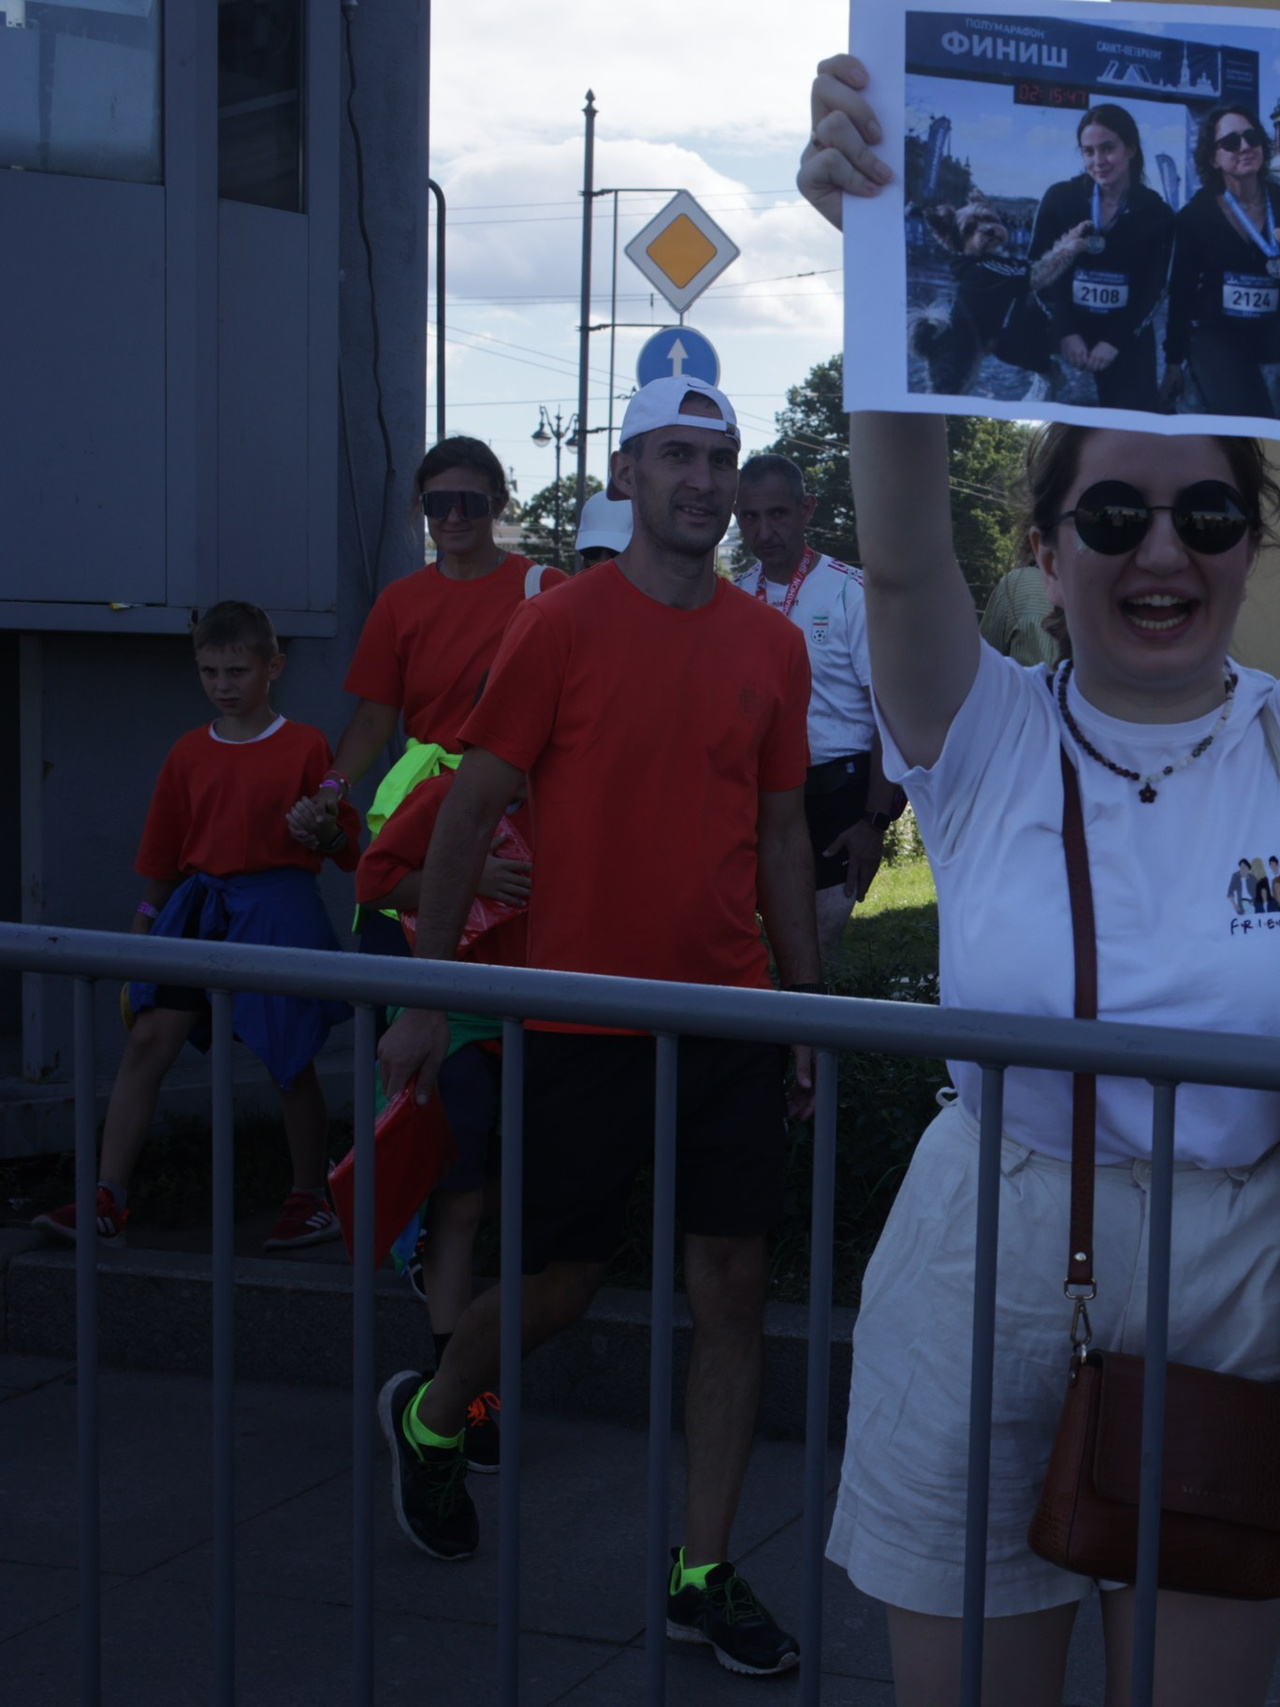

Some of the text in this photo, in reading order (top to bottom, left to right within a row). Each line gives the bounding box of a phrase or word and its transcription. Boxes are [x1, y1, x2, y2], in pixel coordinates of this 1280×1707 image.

[965, 17, 1045, 40] ПОЛУМАРАФОН
[941, 30, 1068, 69] ФИНИШ
[1096, 41, 1163, 60] САНКТ-ПЕТЕРБУРГ
[1081, 286, 1120, 304] 2108
[1232, 290, 1270, 307] 2124
